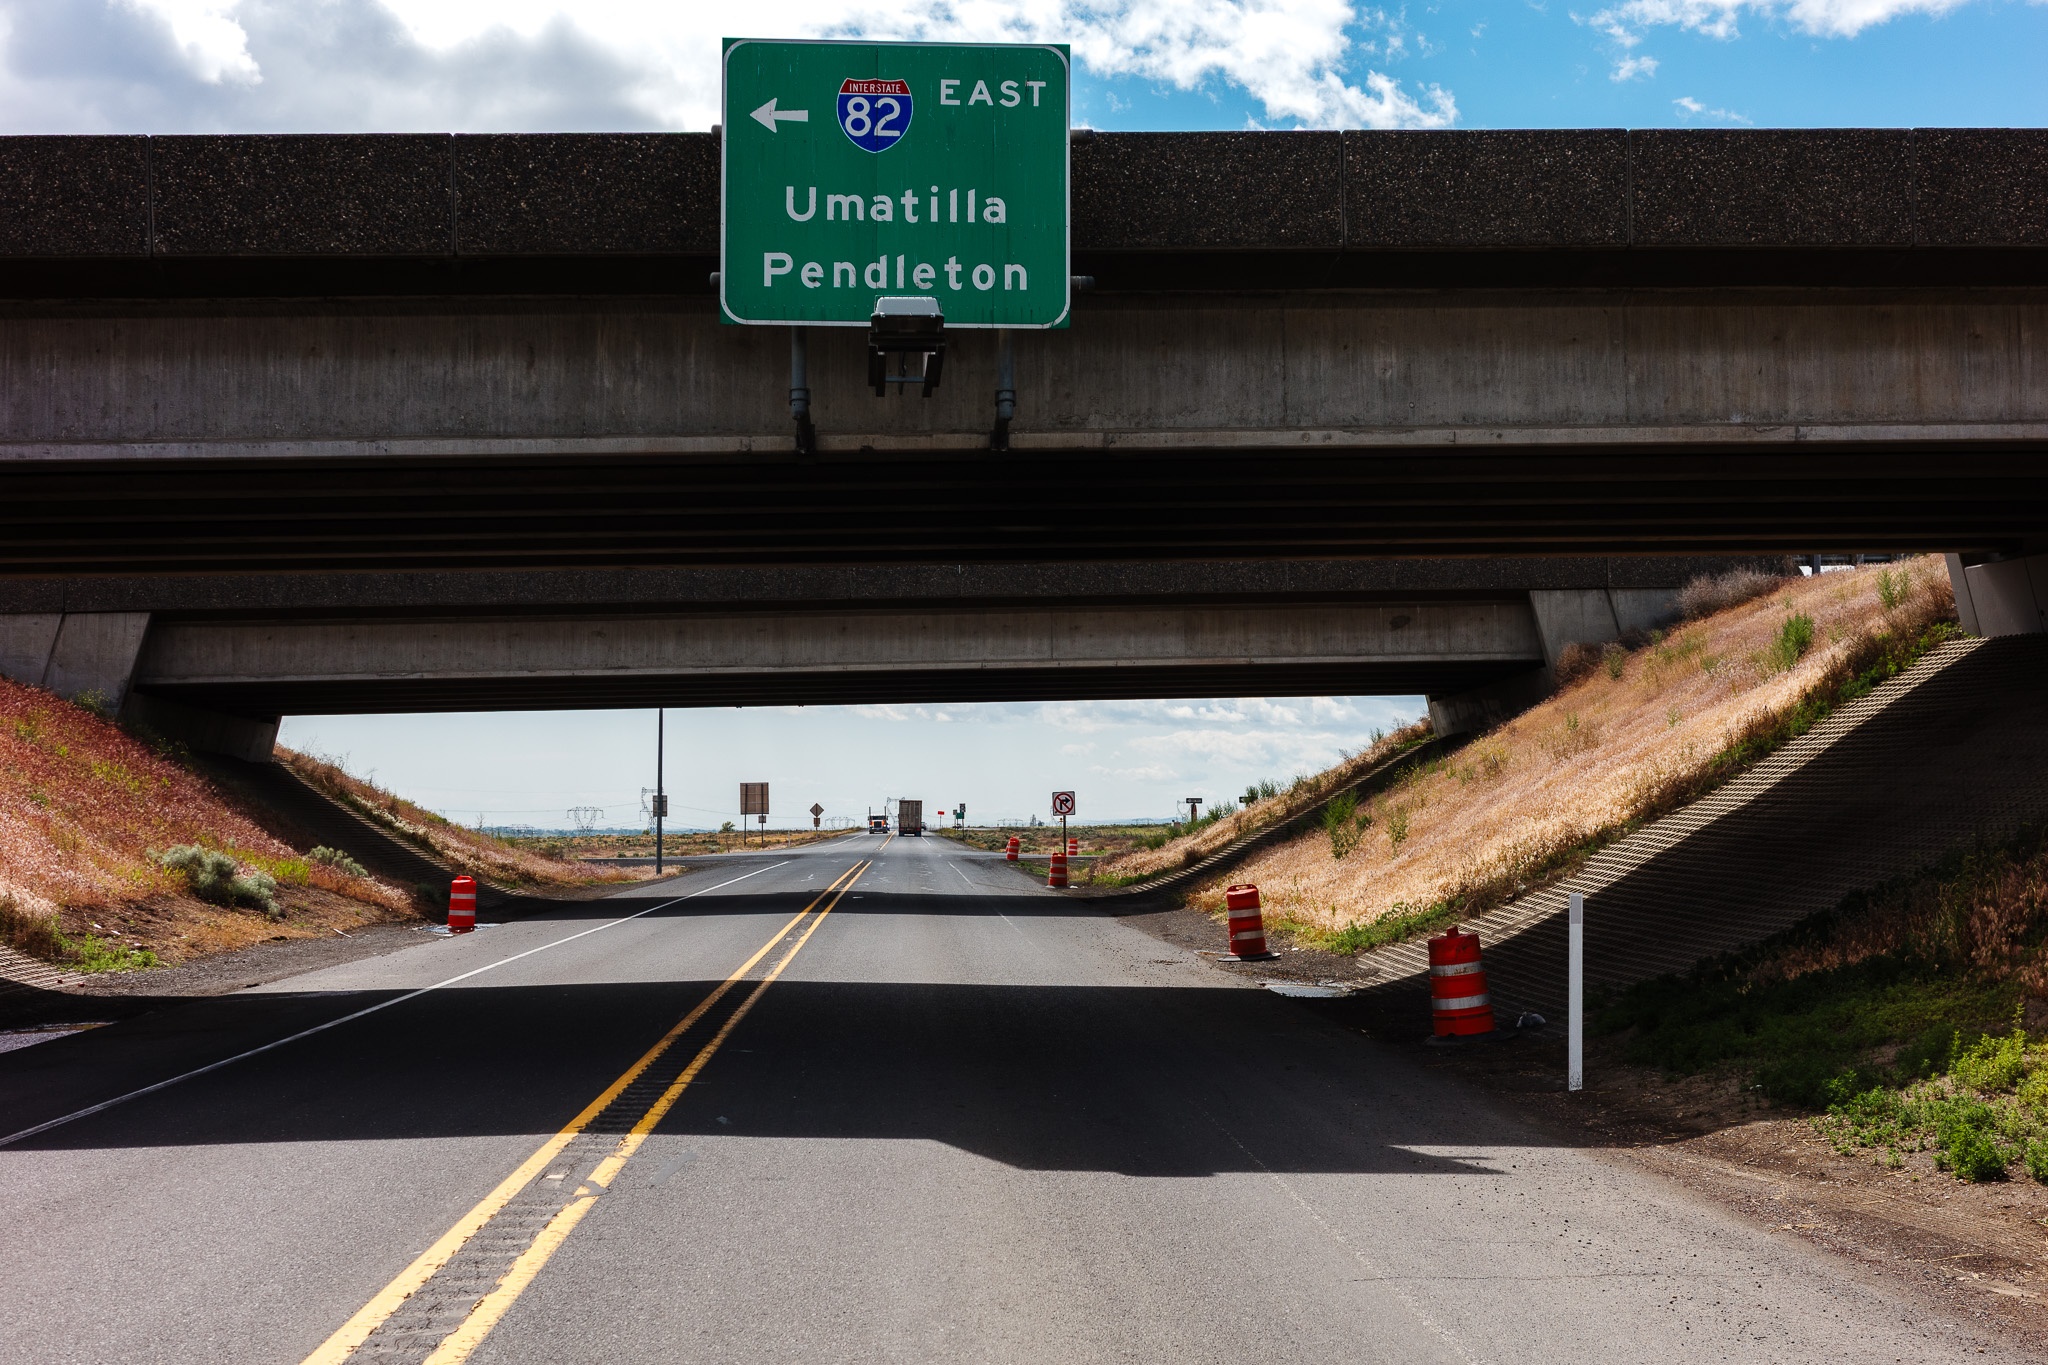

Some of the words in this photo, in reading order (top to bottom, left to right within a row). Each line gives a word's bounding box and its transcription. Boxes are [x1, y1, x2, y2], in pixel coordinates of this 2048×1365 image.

[848, 83, 902, 94] INTERSTATE
[940, 79, 1046, 107] EAST
[844, 97, 901, 138] 82
[786, 185, 1006, 224] Umatilla
[763, 252, 1028, 291] Pendleton
